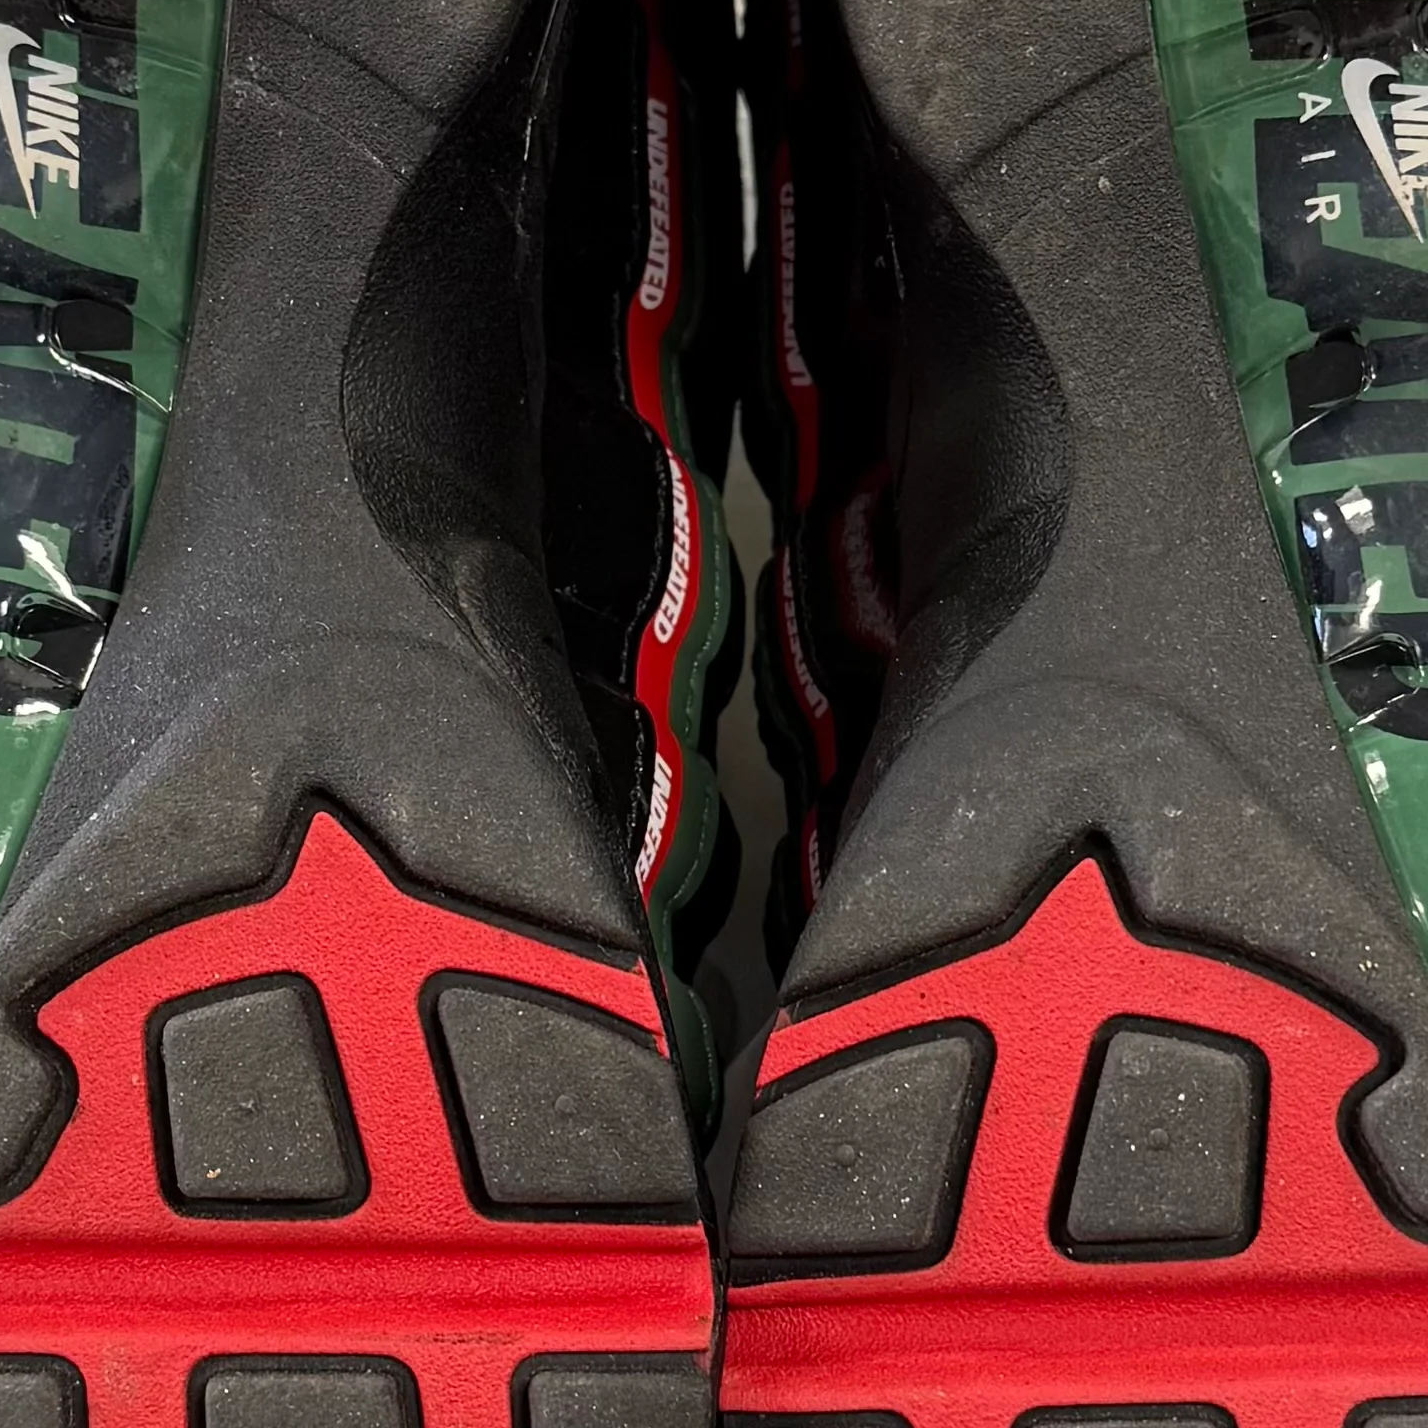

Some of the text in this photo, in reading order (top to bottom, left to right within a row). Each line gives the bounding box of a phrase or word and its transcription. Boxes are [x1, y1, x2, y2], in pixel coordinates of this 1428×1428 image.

[25, 53, 81, 190] NIKE
[1297, 90, 1343, 225] AIR
[639, 97, 670, 311] UNDEFEATED
